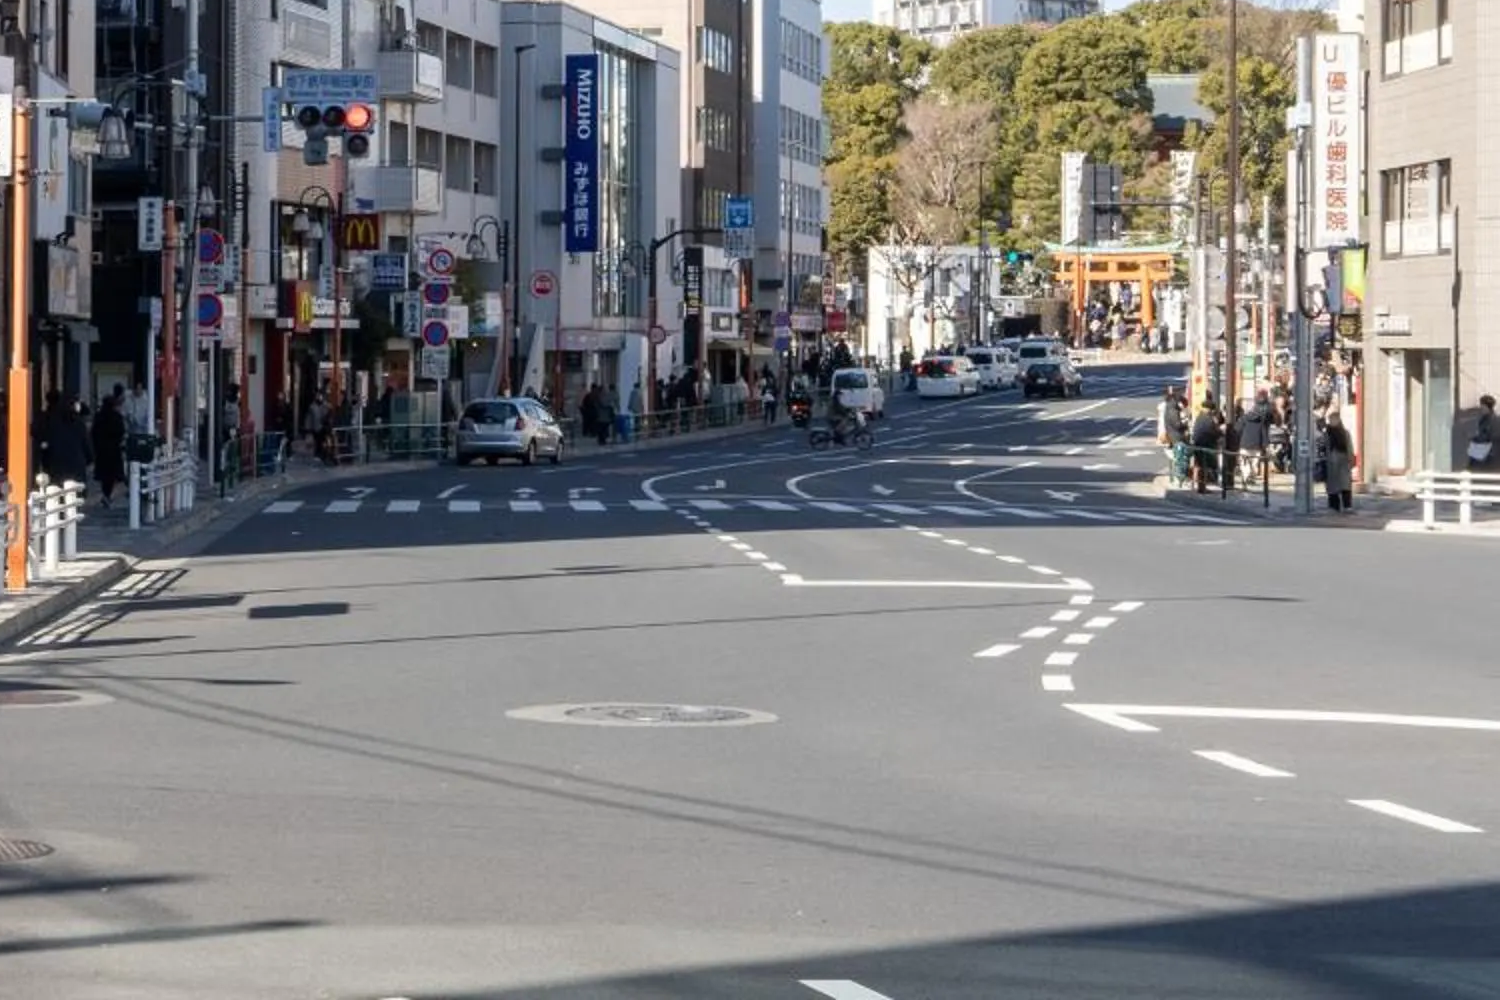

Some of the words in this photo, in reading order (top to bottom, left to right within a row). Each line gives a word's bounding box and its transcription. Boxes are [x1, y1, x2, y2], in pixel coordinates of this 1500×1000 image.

[576, 68, 593, 140] MIZUHO
[1326, 71, 1348, 232] 優ビル歯科医院
[573, 161, 590, 239] みずほ銀行
